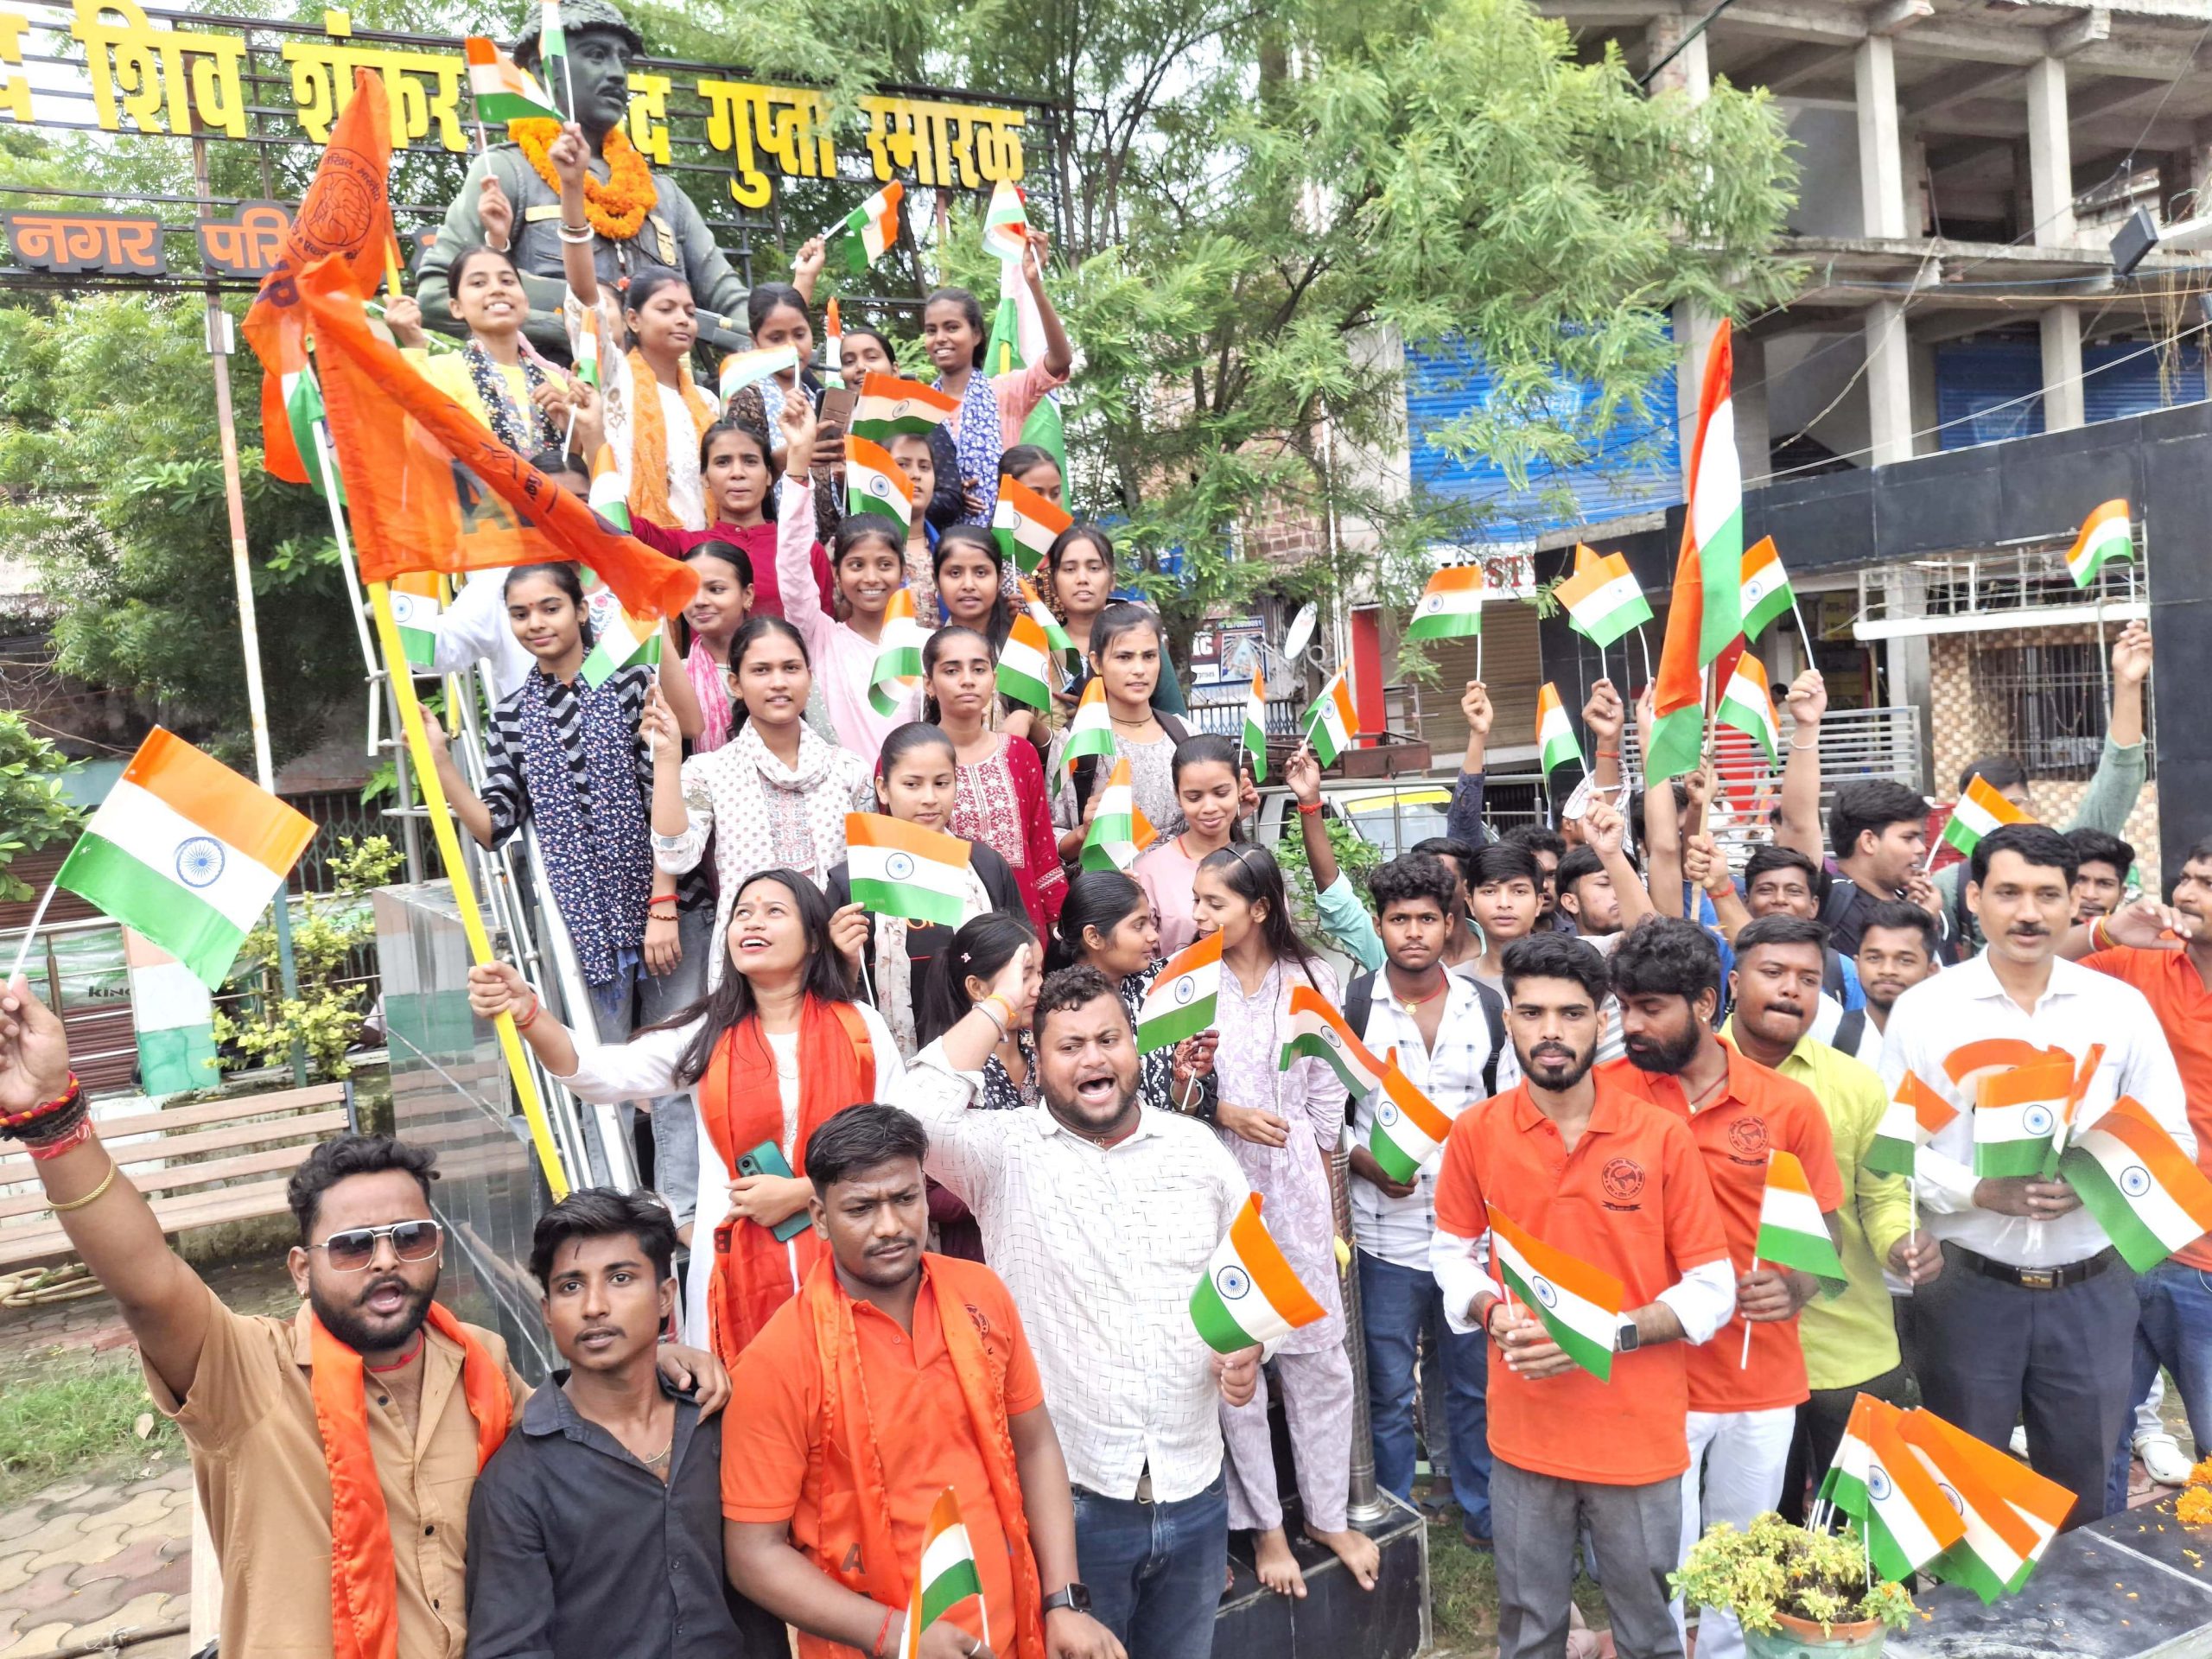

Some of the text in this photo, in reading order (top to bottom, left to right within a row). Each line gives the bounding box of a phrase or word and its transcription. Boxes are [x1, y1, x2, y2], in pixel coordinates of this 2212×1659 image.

[70, 0, 247, 139] शिव
[282, 10, 468, 153] शंकर
[697, 79, 836, 208] गुप्ता
[12, 207, 292, 270] नगर परि
